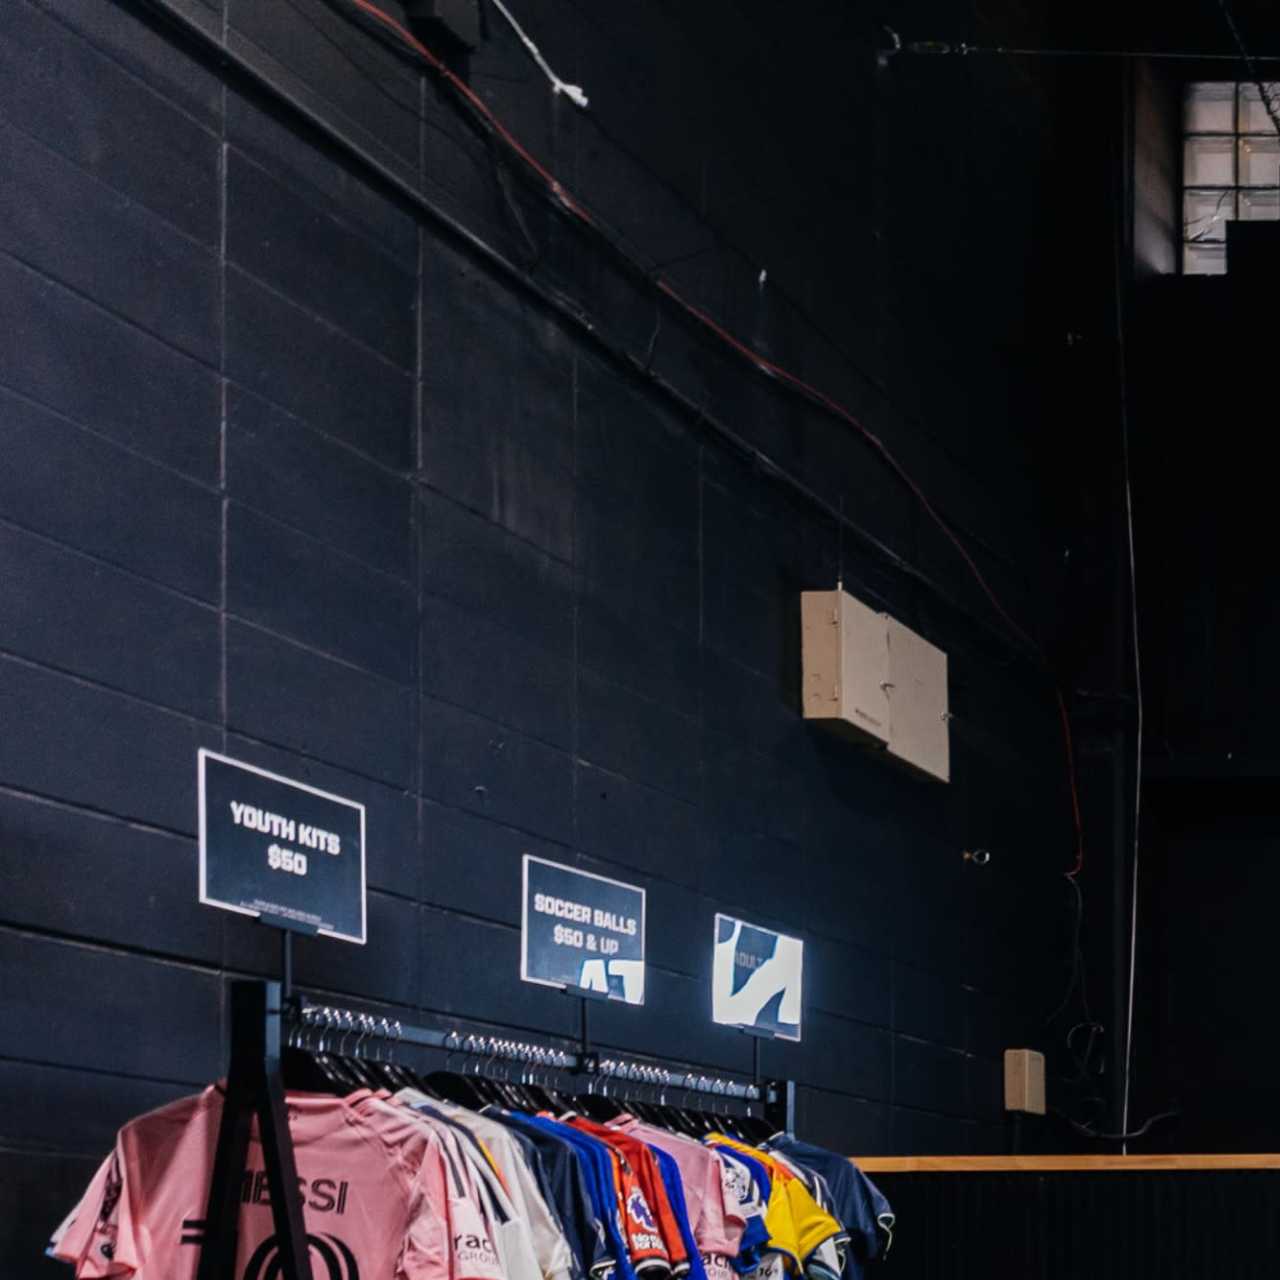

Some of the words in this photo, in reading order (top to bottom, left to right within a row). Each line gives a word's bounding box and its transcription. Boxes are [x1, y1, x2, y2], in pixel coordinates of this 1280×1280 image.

[230, 800, 295, 841] YOUTH
[298, 823, 341, 855] KITS
[534, 893, 592, 924] SOCCER
[593, 909, 637, 936] BALLS
[586, 933, 597, 951] &
[600, 936, 619, 955] UP
